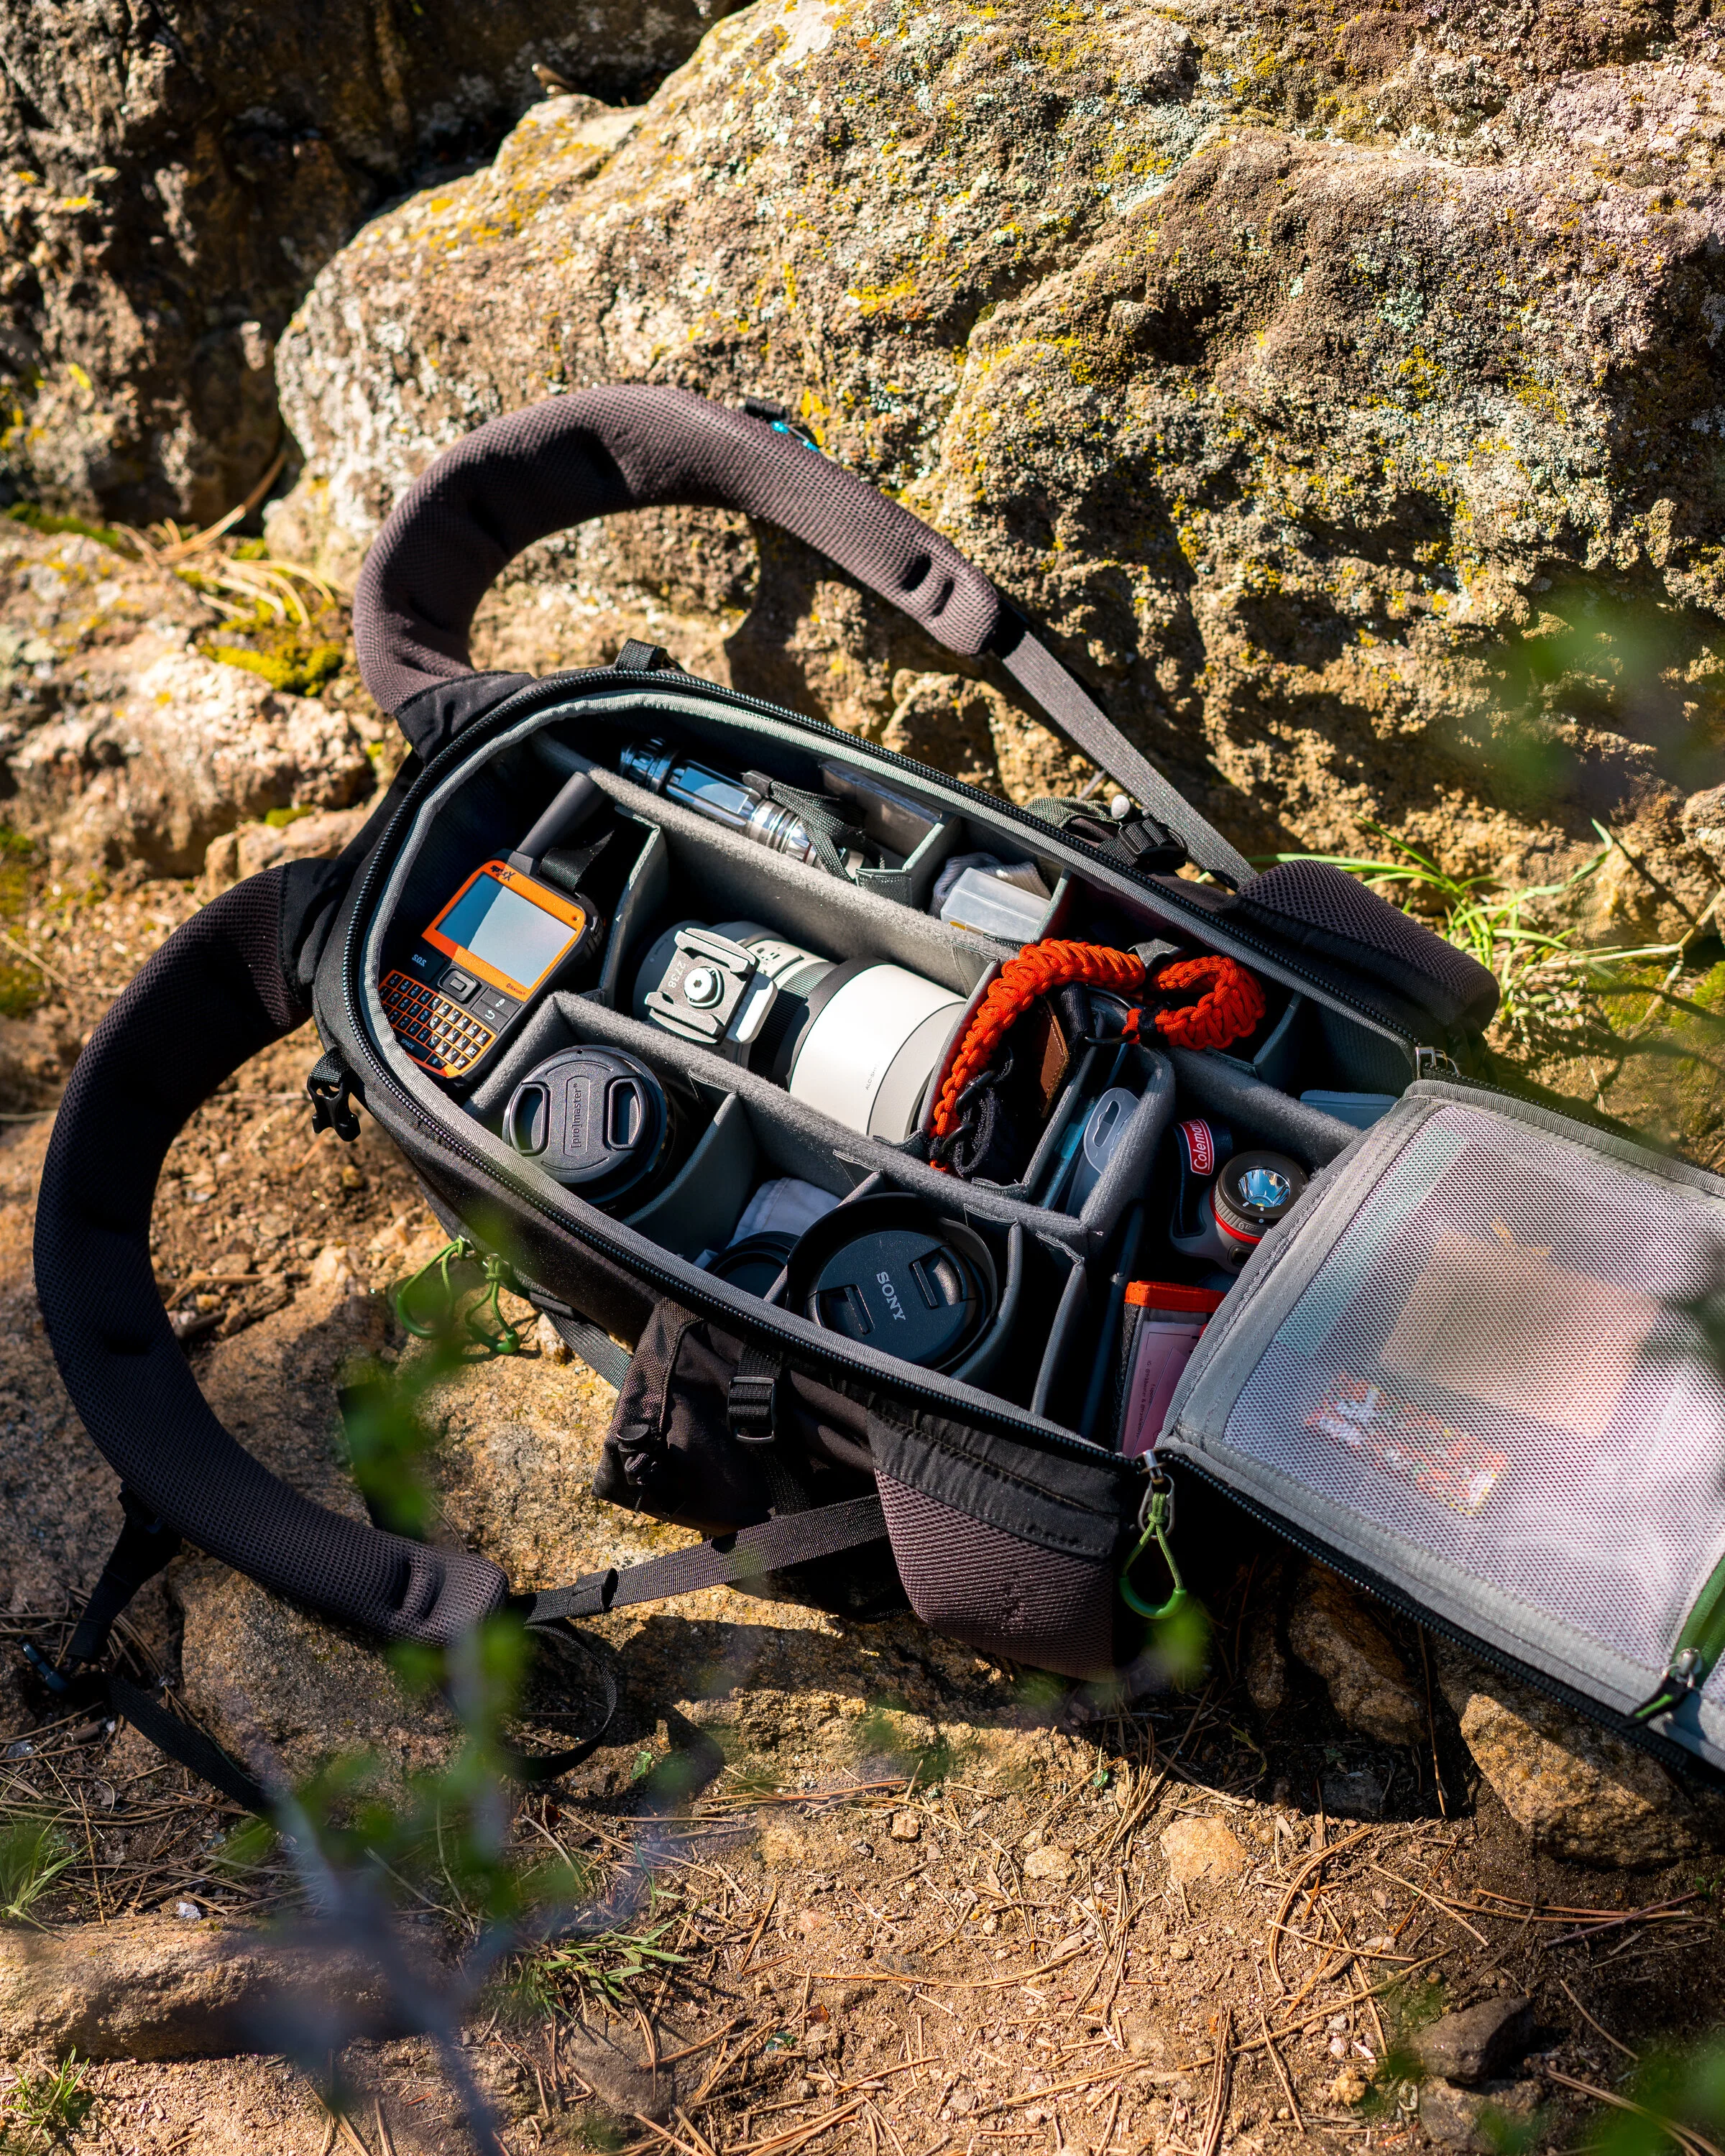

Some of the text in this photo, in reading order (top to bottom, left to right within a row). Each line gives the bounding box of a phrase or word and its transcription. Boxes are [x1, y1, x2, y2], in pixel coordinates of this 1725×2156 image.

[412, 954, 427, 967] S.O.S.
[668, 960, 686, 988] 2738
[400, 1038, 415, 1049] SPACE
[1190, 1123, 1208, 1169] Coleman
[876, 1271, 906, 1321] SONY
